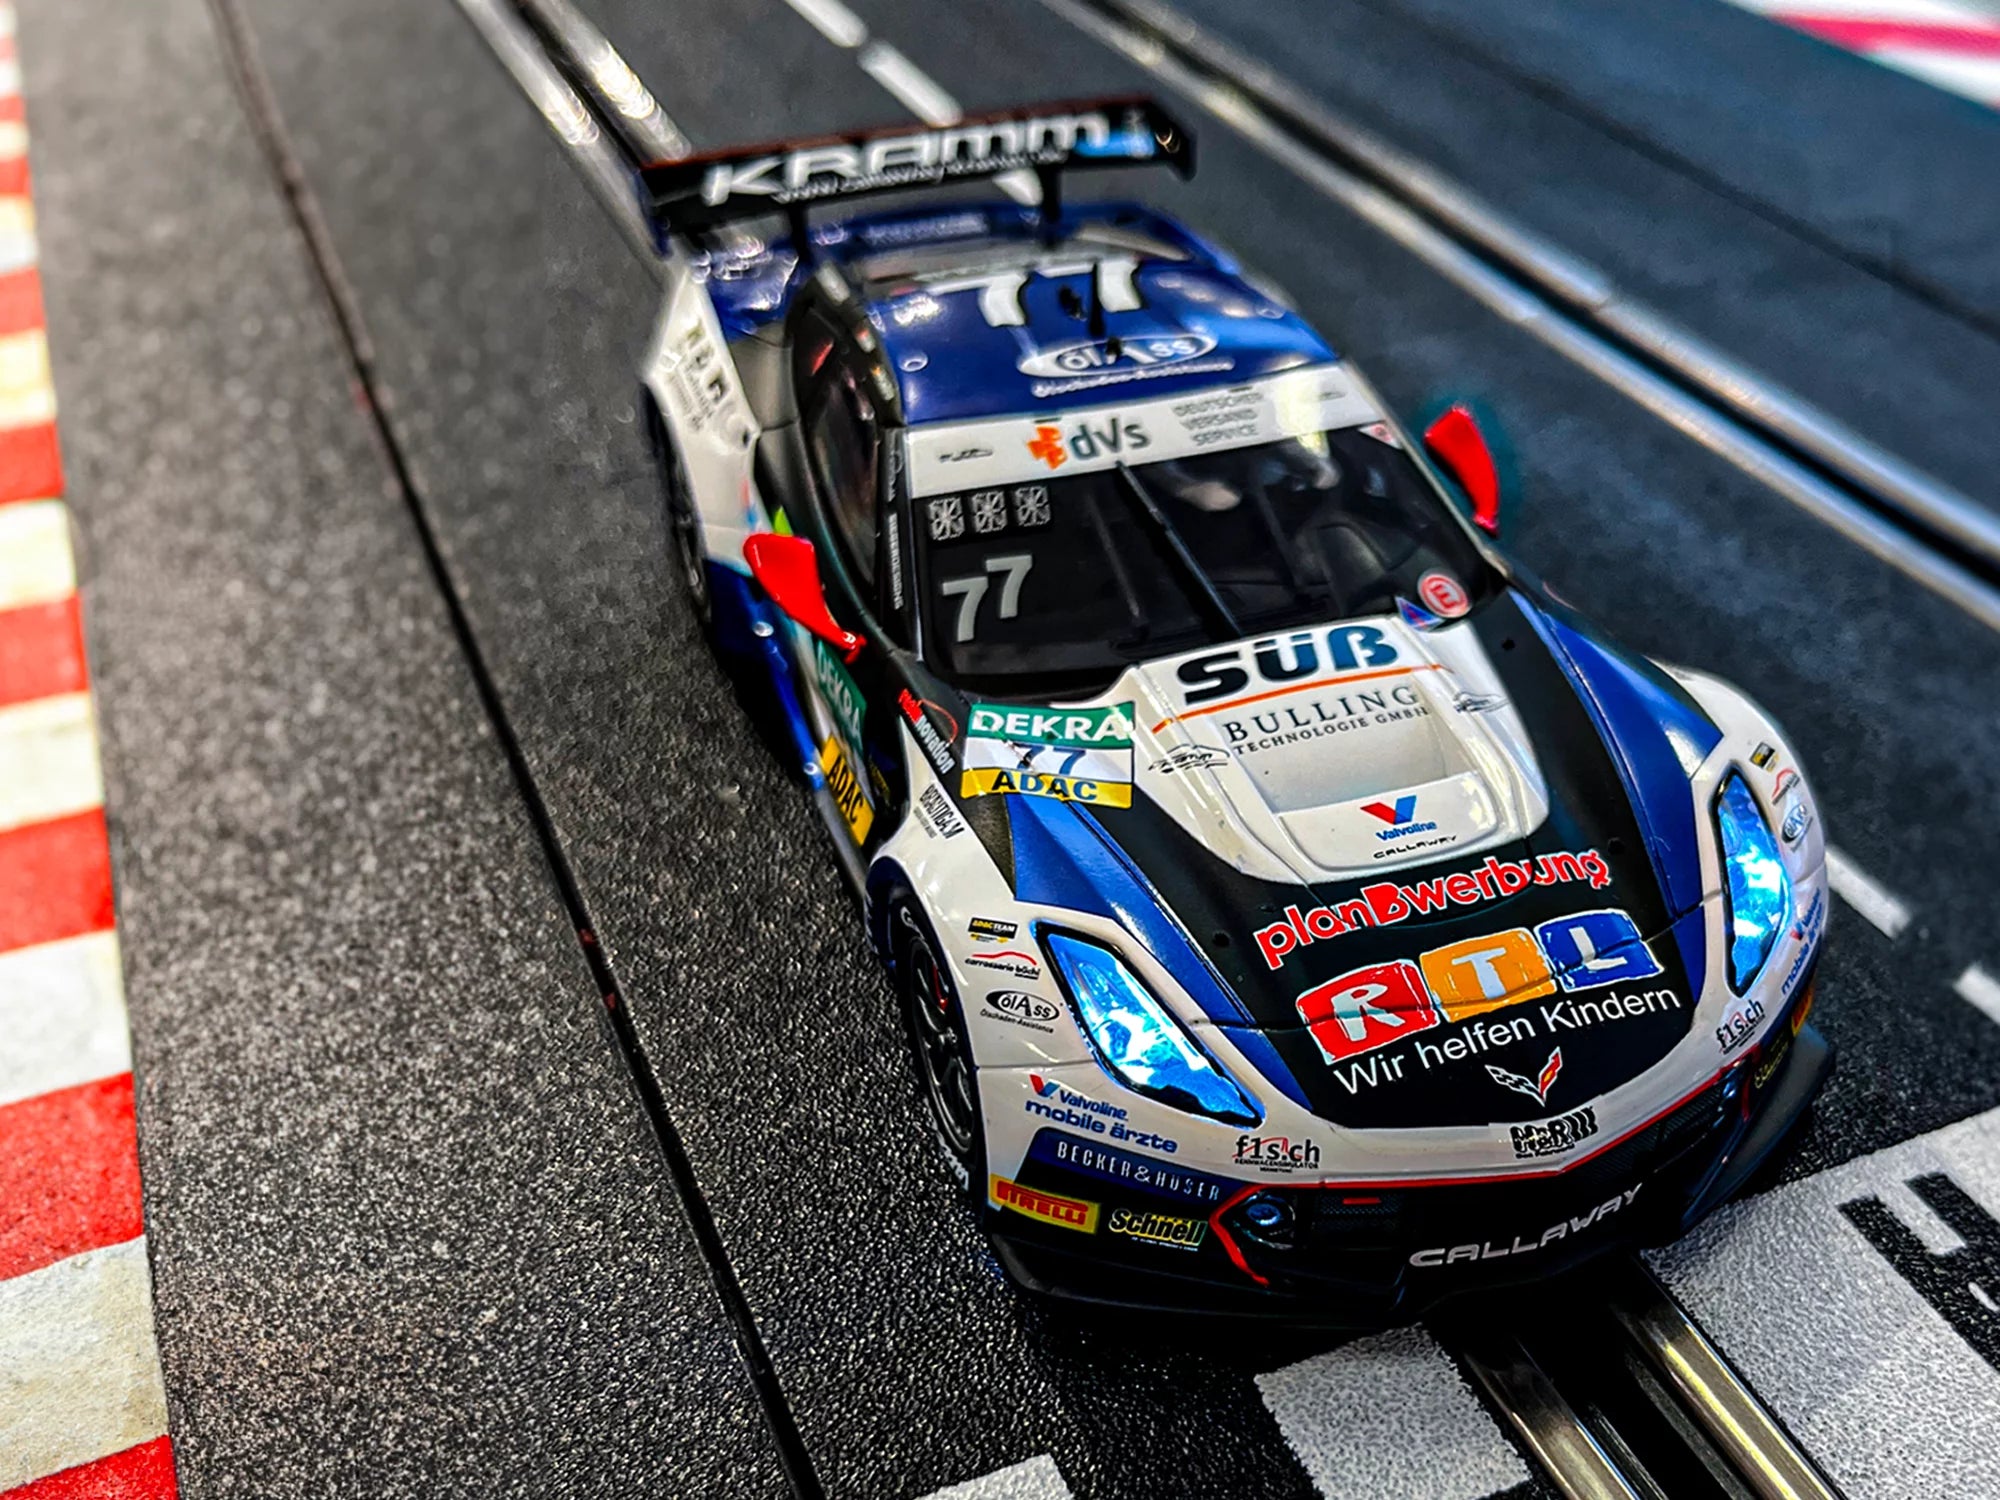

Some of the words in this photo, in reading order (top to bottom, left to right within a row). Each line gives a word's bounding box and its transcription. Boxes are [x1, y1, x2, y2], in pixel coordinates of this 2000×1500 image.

[942, 554, 1033, 642] 77
[972, 710, 1134, 741] DEKRA
[1223, 685, 1418, 743] BULLING
[1233, 717, 1370, 755] TECHNOLOGIE
[1375, 705, 1430, 725] GMBH
[1014, 743, 1087, 776] 77
[828, 751, 864, 824] ADAC
[992, 771, 1098, 801] ADAC
[1373, 835, 1457, 859] CALLAWAY
[1375, 821, 1437, 841] Valvoline
[1322, 922, 1636, 1048] RTL
[1333, 1050, 1404, 1095] Wir
[1414, 1015, 1536, 1070] helfen
[1545, 988, 1681, 1034] Kindern
[1025, 1100, 1106, 1134] mobile
[1109, 1122, 1178, 1153] ärzte
[1060, 1089, 1128, 1121] Valvoline
[997, 1180, 1088, 1225] PIRELLI
[1409, 1183, 1642, 1267] CALLAWAY
[1109, 1209, 1207, 1246] Schnell
